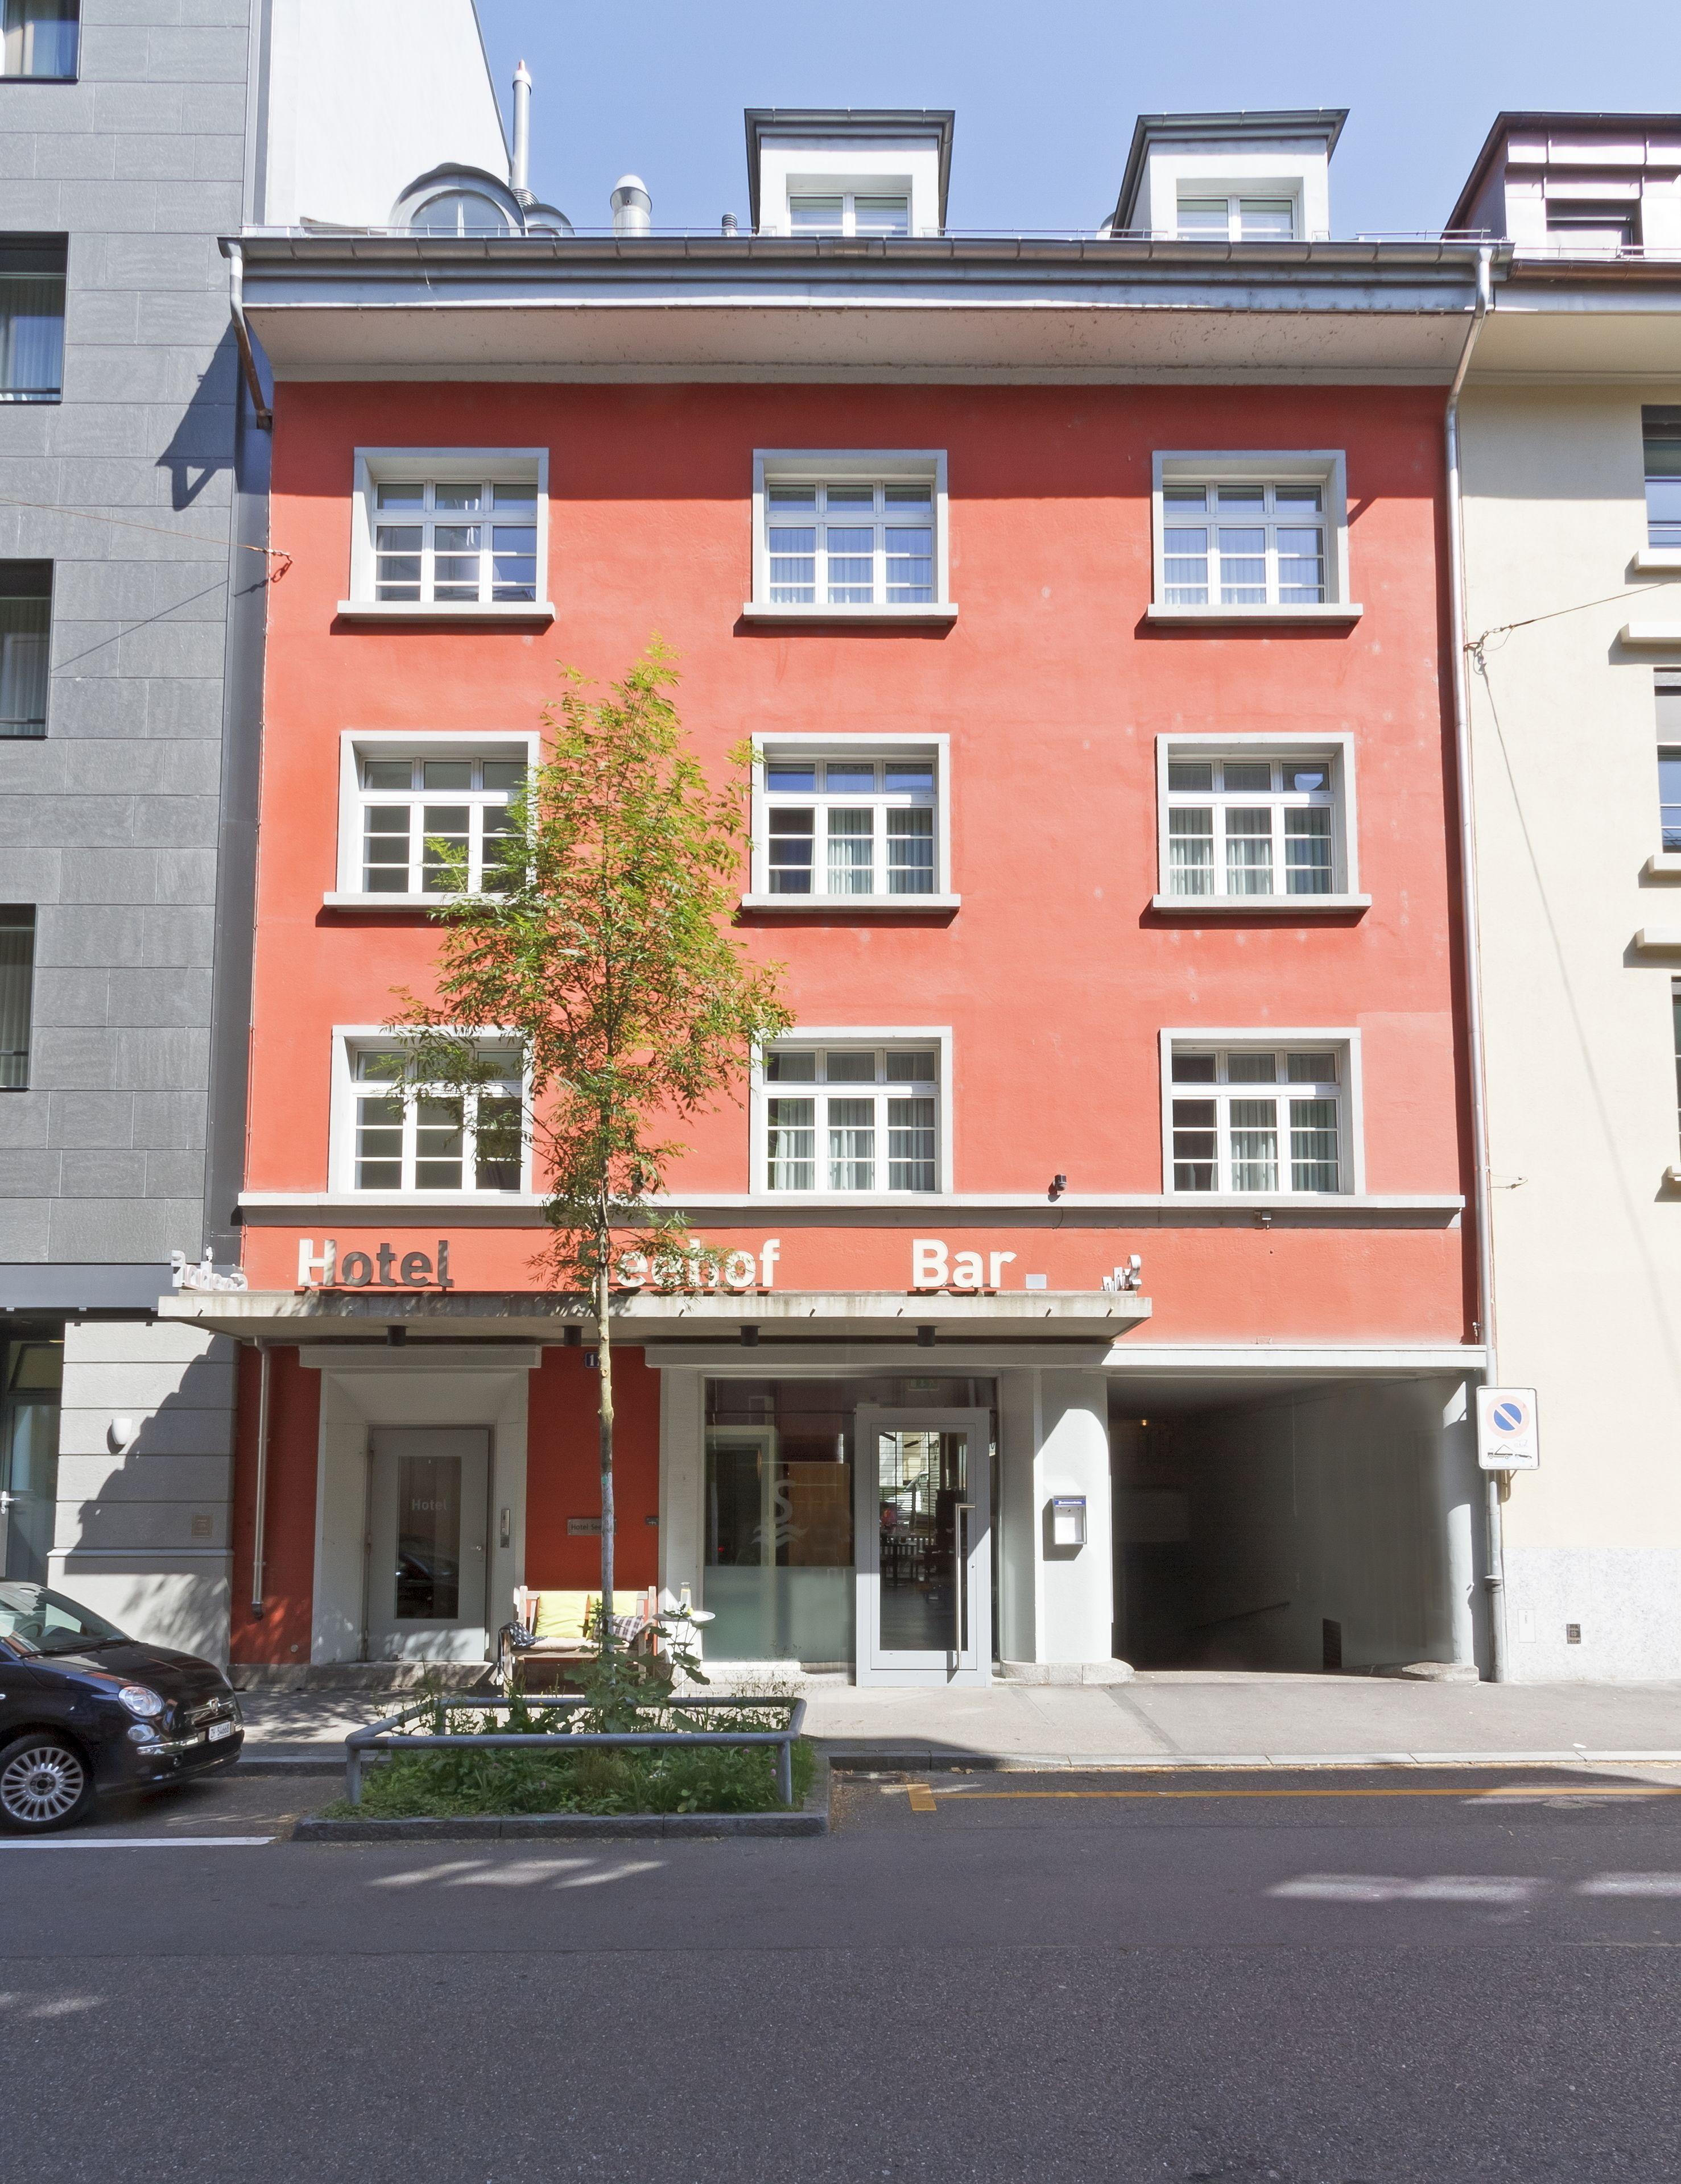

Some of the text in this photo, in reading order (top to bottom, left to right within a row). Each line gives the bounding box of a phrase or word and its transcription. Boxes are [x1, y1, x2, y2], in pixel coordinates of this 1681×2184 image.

[298, 1238, 454, 1288] Hotel
[912, 1239, 1017, 1288] Bar
[412, 1498, 447, 1511] Hotel
